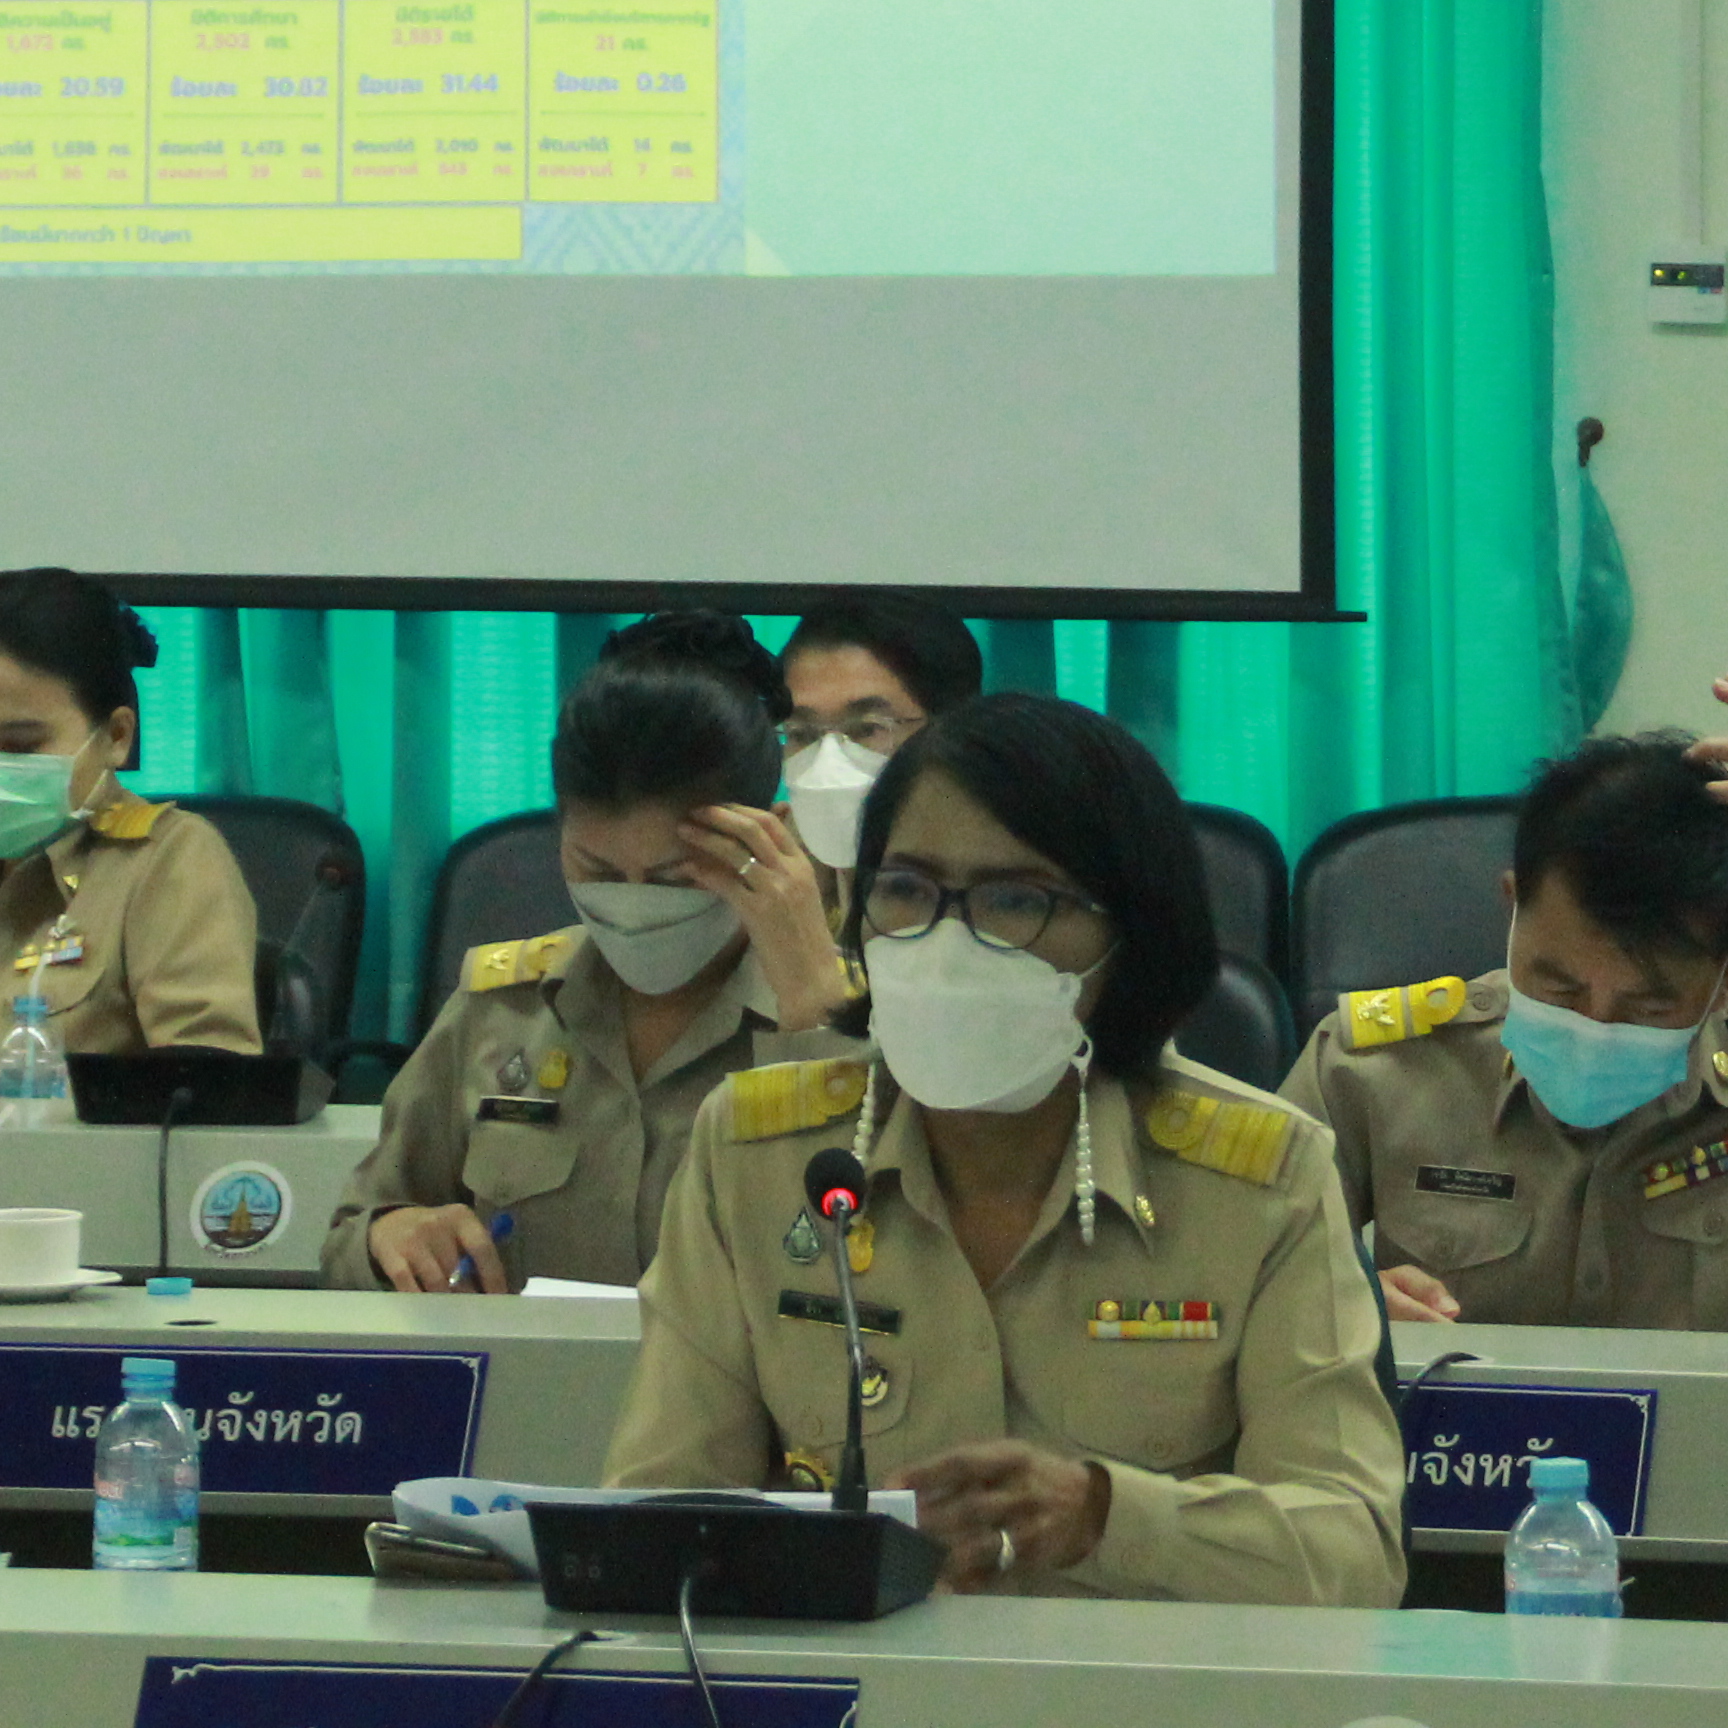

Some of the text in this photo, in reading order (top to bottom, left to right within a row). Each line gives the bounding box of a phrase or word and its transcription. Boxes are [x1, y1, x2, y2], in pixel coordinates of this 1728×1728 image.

[595, 34, 616, 52] 21
[60, 76, 126, 98] 20.59
[263, 76, 329, 98] 30.82
[440, 73, 499, 94] 31.44
[51, 1391, 362, 1444] แรนจังหวัด
[1407, 1434, 1554, 1489] จังหั
